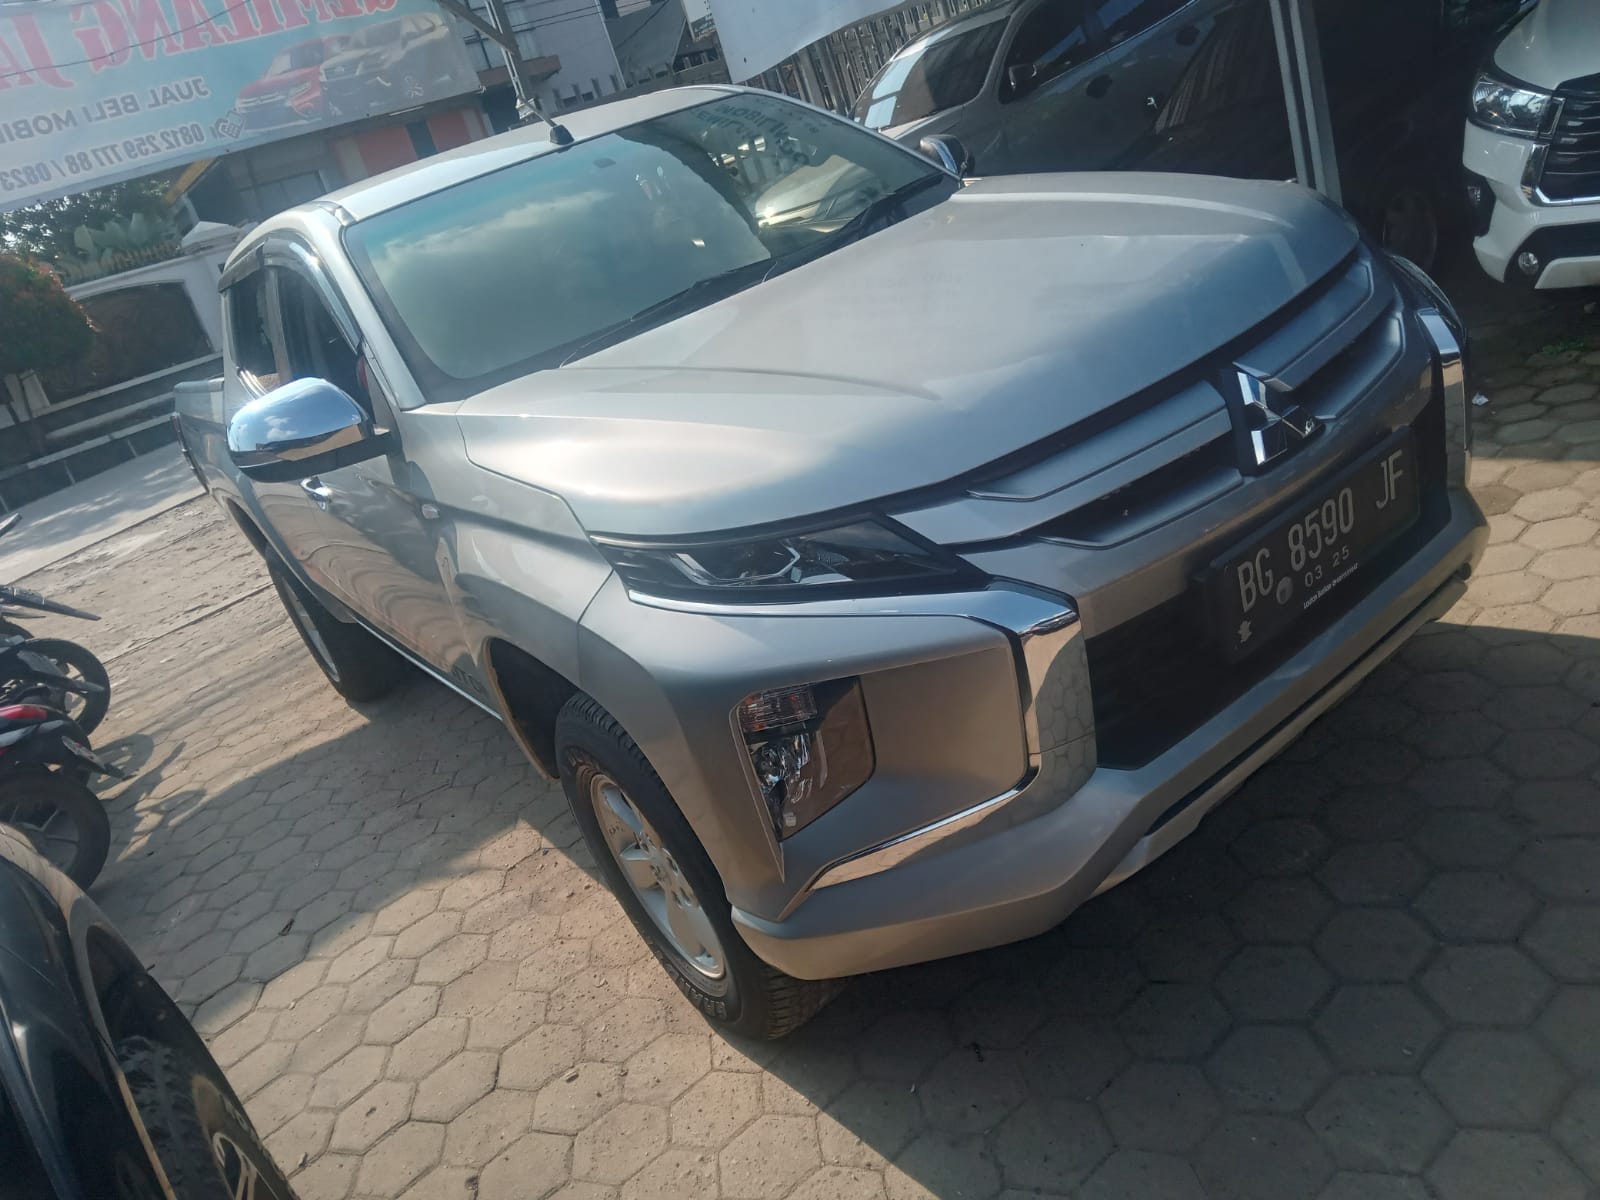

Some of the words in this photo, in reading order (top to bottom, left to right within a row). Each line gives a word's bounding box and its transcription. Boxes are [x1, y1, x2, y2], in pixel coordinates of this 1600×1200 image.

[1237, 548, 1274, 613] BG
[1288, 487, 1354, 572] 8590
[1376, 450, 1404, 509] JF
[1304, 564, 1323, 588] 03
[1332, 545, 1350, 567] 25
